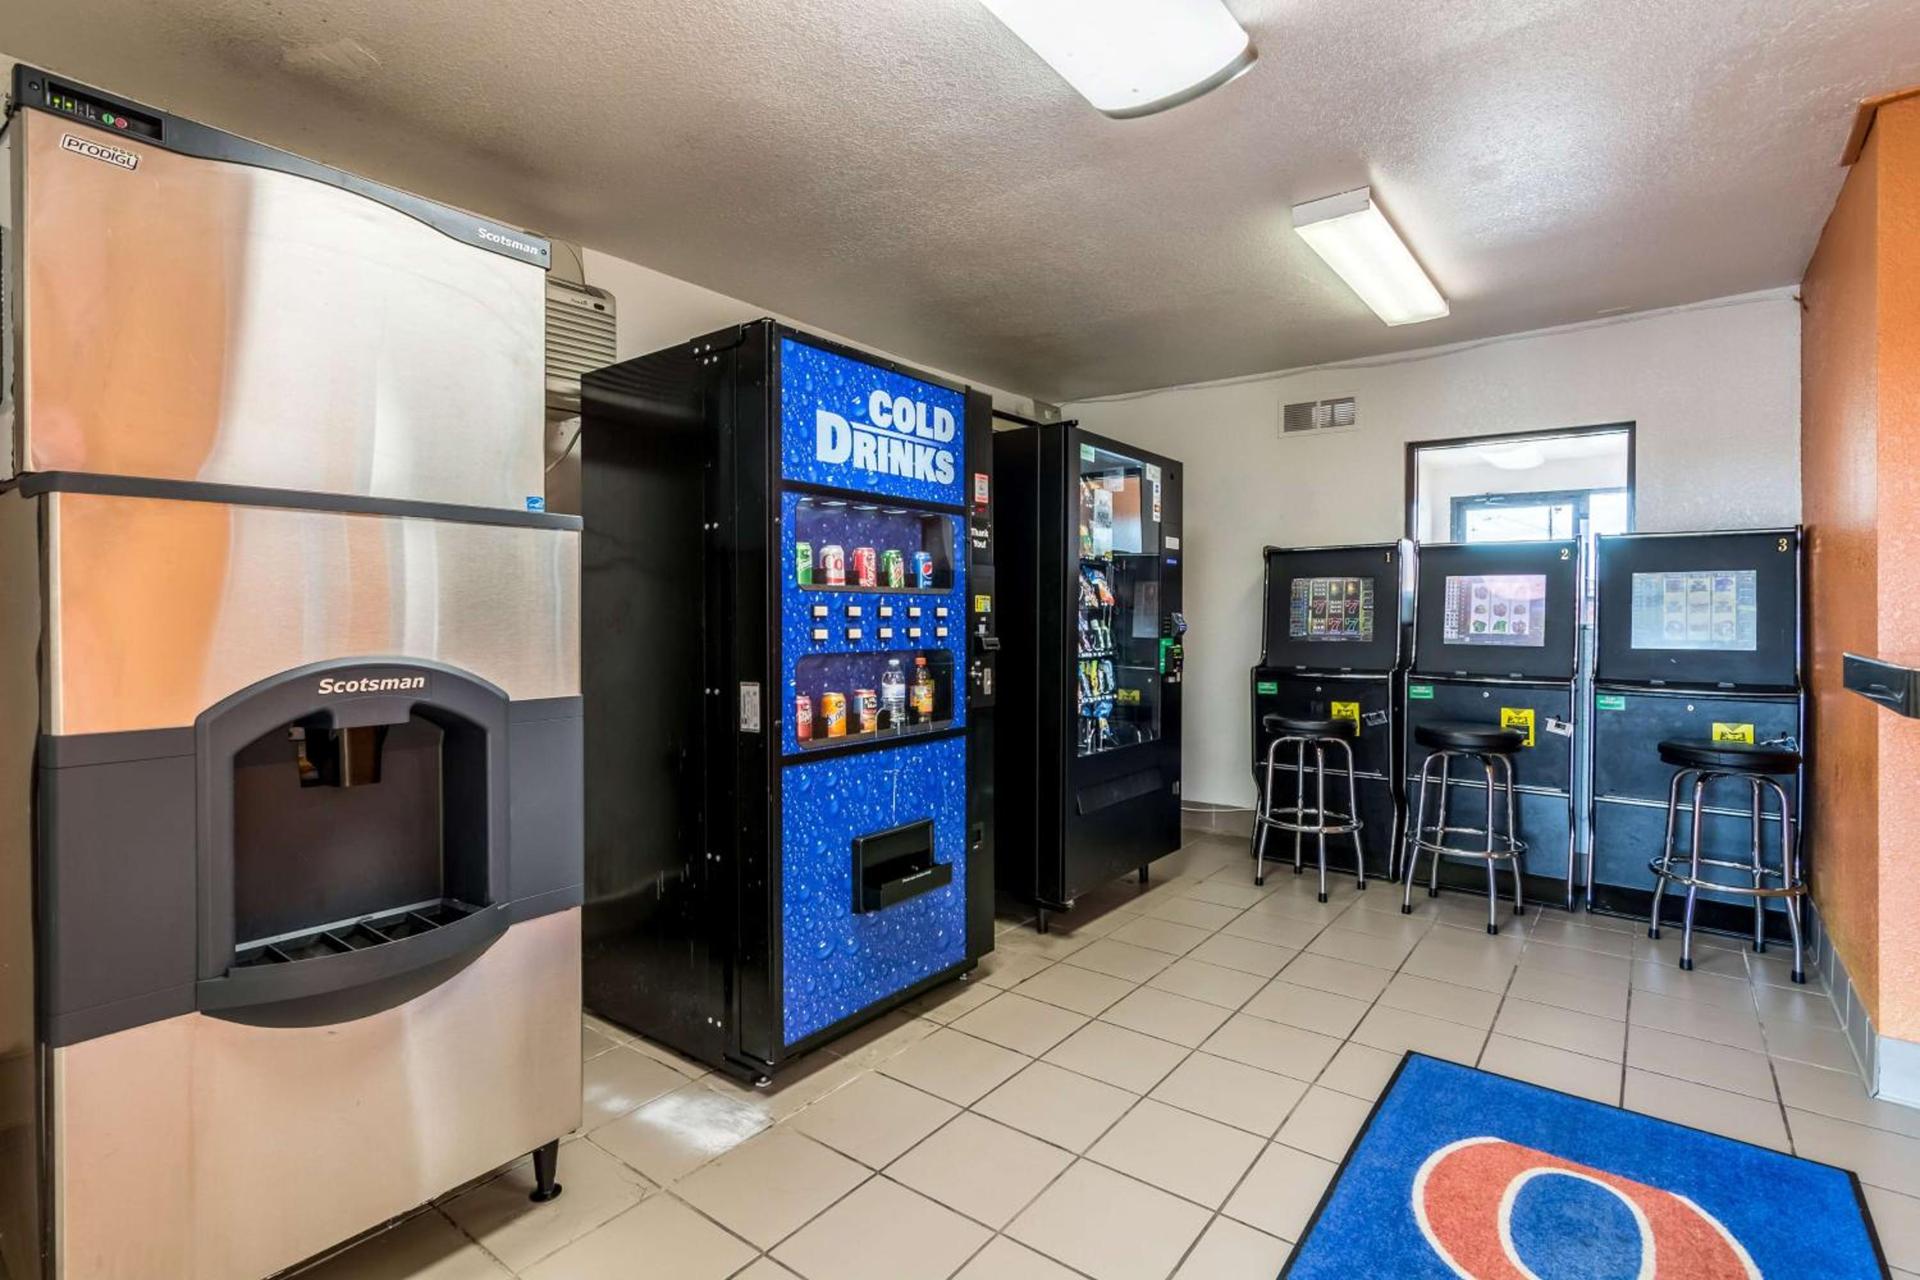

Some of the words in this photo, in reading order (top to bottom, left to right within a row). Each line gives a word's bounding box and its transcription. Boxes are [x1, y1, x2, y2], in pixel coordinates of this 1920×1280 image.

[477, 227, 539, 256] Scotsman
[868, 389, 956, 444] COLD
[815, 409, 955, 485] DRINKS
[1560, 547, 1569, 560] 2
[1778, 537, 1788, 552] 3
[317, 676, 425, 695] Scotsman
